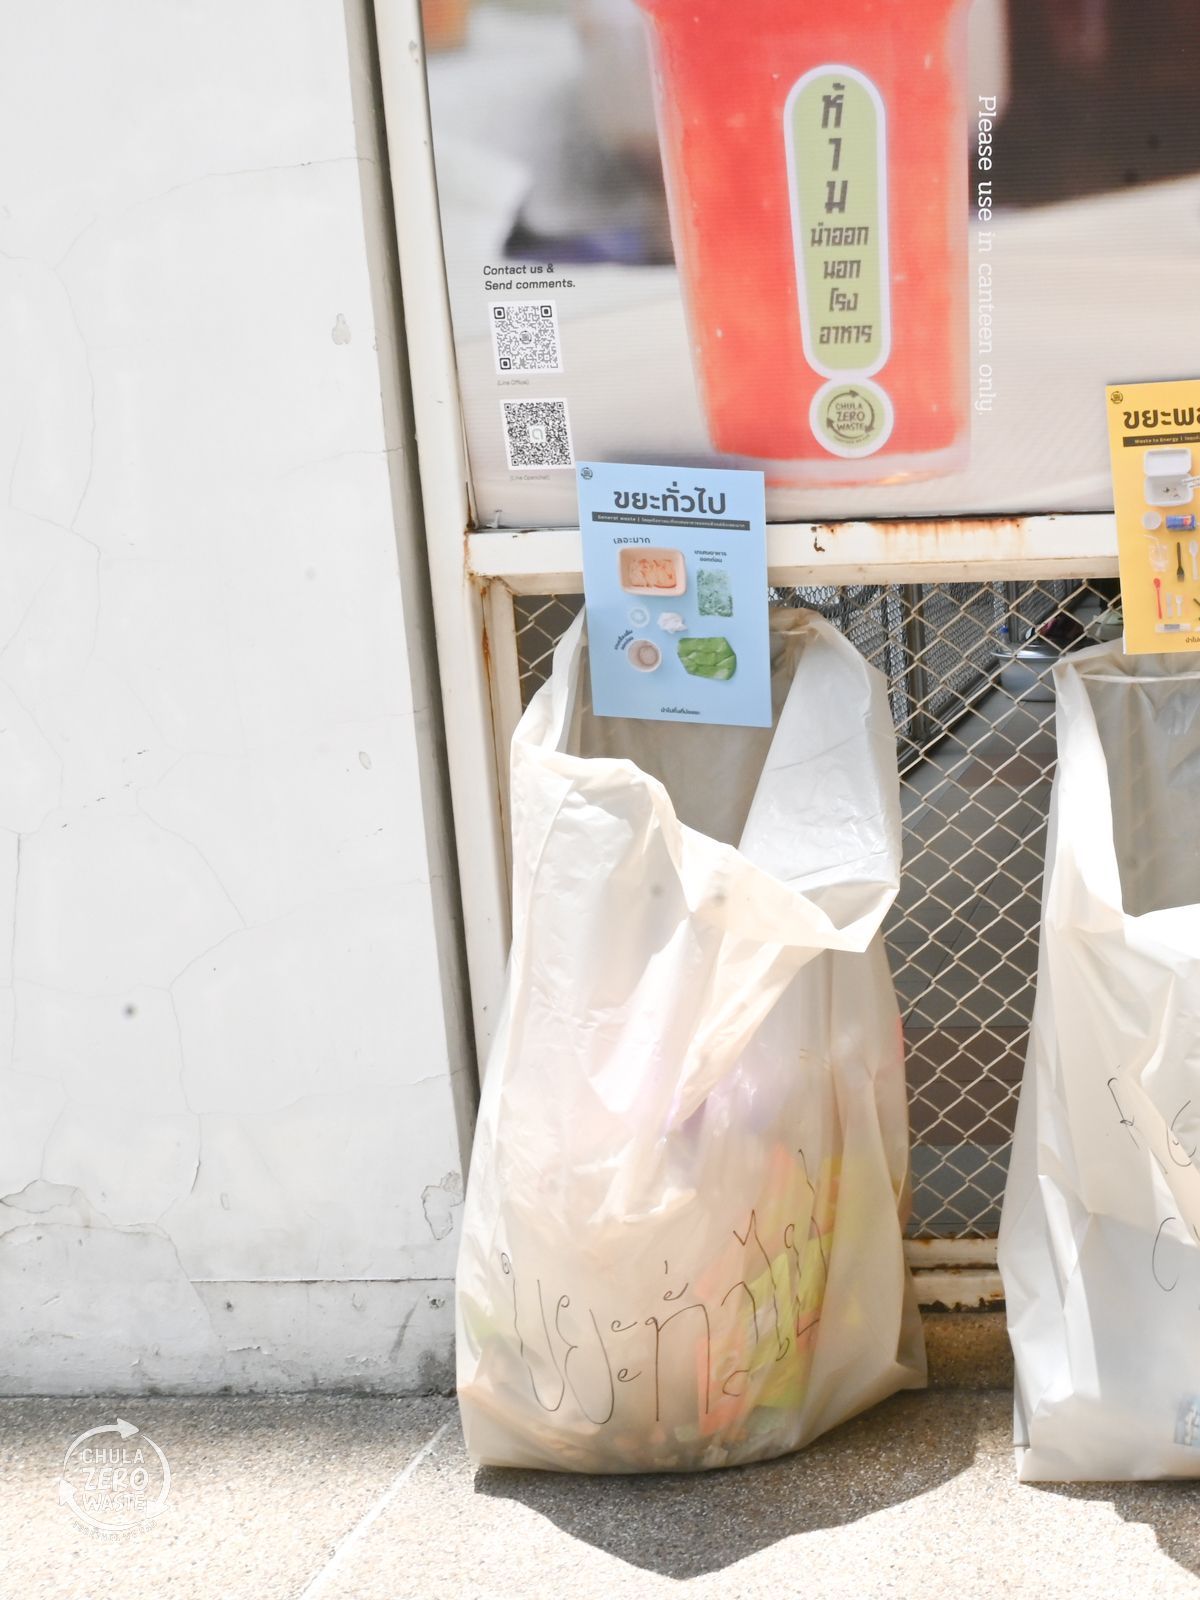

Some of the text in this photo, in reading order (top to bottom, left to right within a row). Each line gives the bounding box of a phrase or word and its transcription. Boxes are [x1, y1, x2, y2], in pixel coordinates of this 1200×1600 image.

[811, 221, 870, 247] นำออก
[975, 95, 996, 416] Please use in canteen only.
[483, 264, 554, 276] Contact us &
[823, 259, 862, 280] นอก
[484, 278, 576, 291] Send comments.
[828, 288, 859, 313] โรง
[819, 324, 873, 344] อาหาร
[835, 402, 863, 411] CHULA
[836, 411, 865, 422] ZERO
[836, 422, 865, 431] WASTE
[613, 481, 727, 515] ขยะทั่วไป
[613, 536, 651, 545] เลอะมาก
